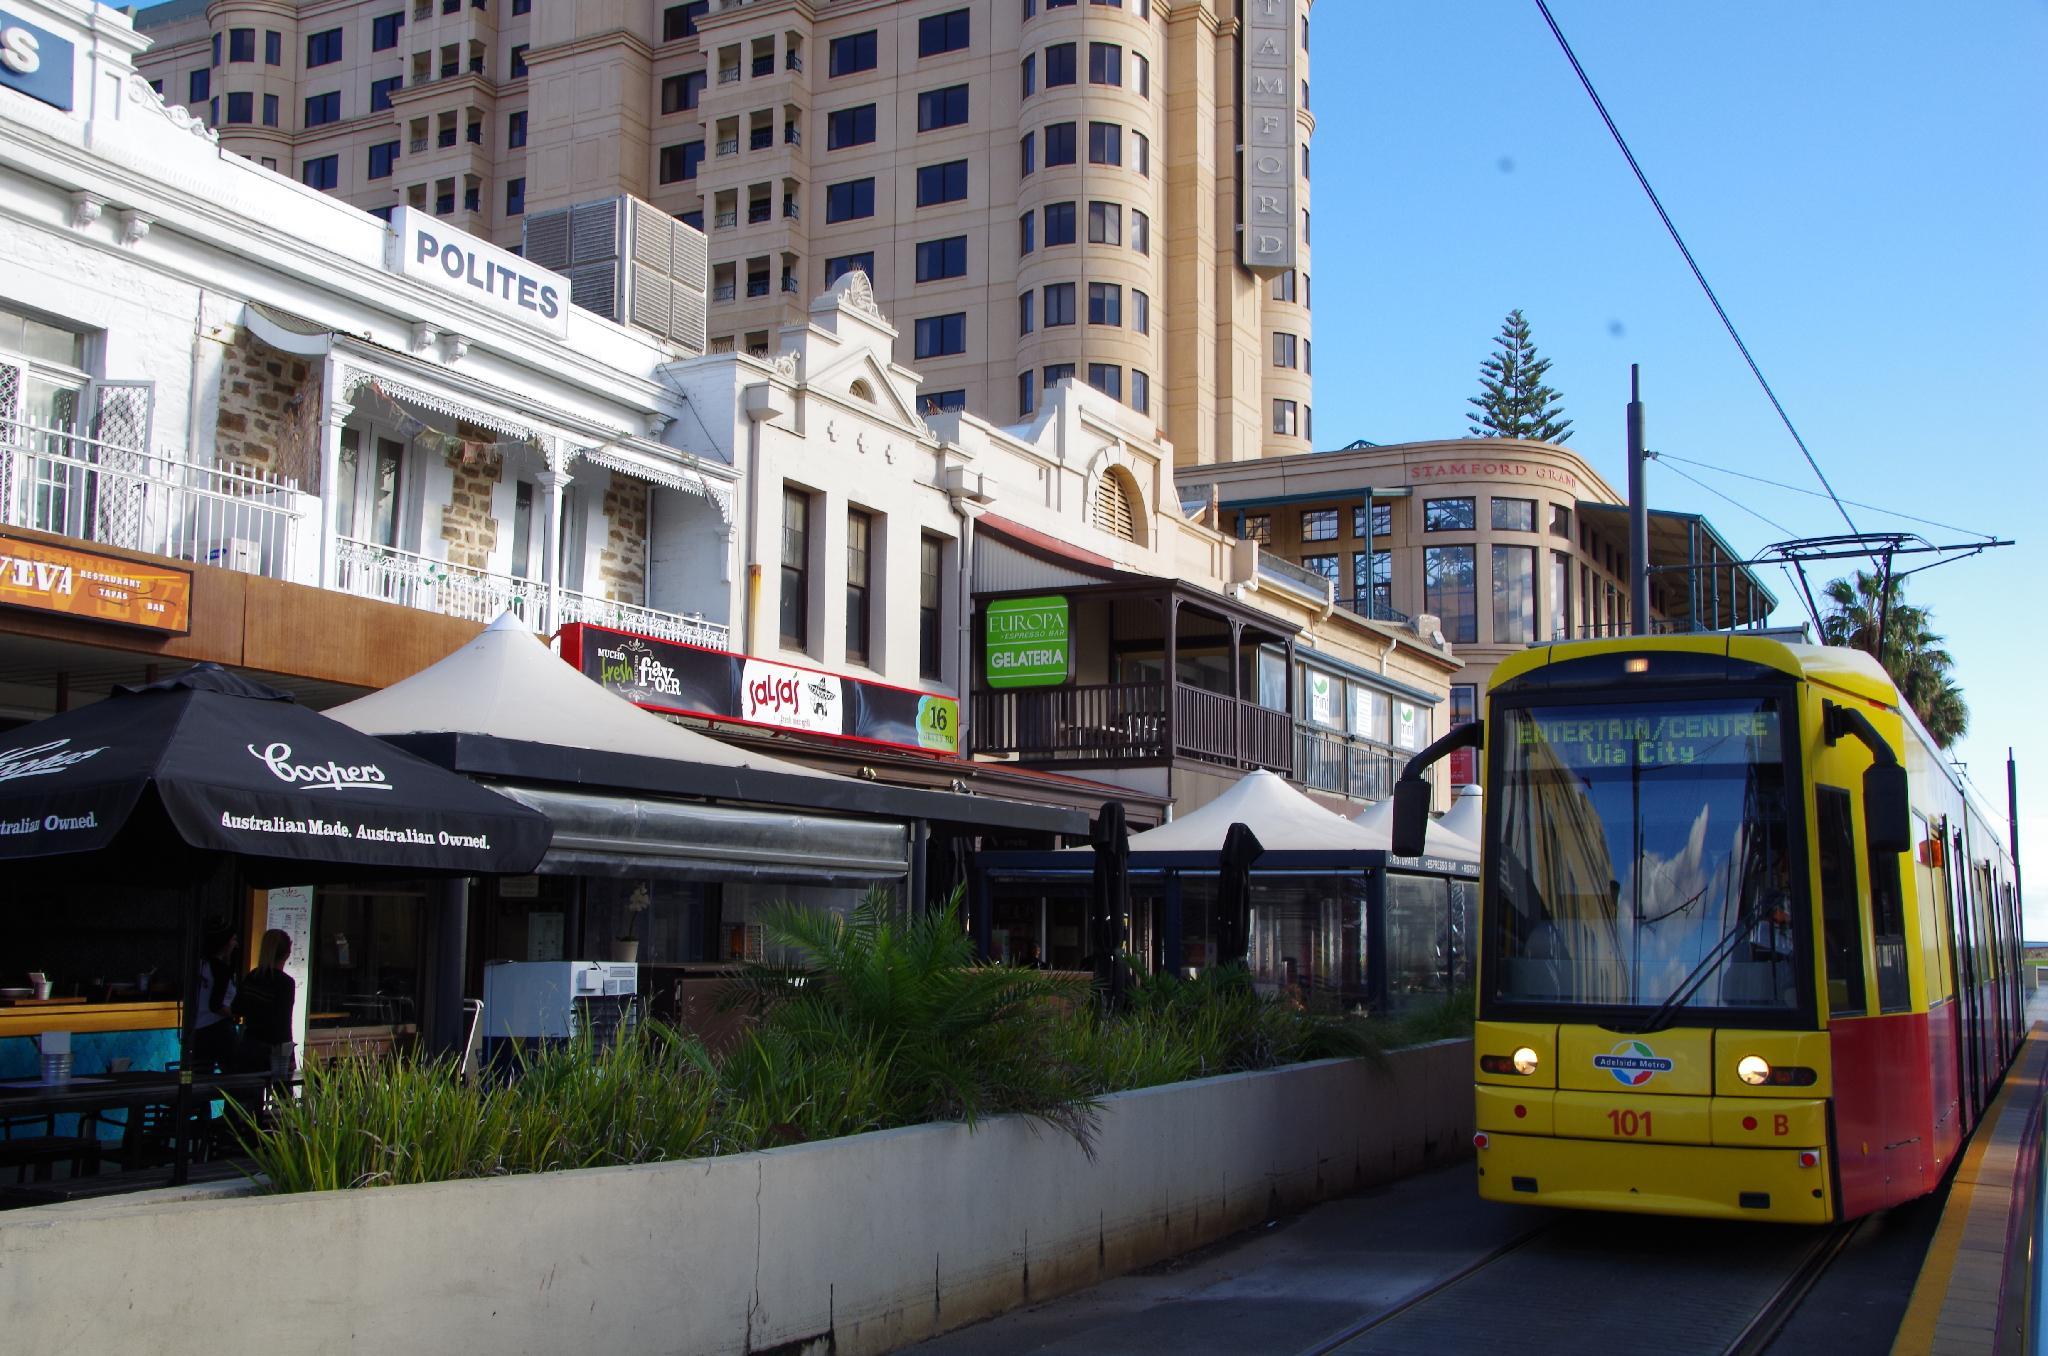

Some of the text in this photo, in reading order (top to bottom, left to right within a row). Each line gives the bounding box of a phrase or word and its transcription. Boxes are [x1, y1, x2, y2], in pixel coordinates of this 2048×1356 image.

[417, 229, 559, 319] POLITES
[1411, 463, 1576, 488] STAMFORD GRAND
[80, 569, 141, 588] RESTAURANT
[99, 588, 128, 600] TAPAS
[147, 602, 165, 613] BAR
[989, 613, 1064, 632] EUROPA
[1048, 629, 1065, 637] BAR
[598, 648, 625, 661] MUCHO
[991, 649, 1064, 668] GELATERIA
[601, 656, 634, 688] fresh
[930, 706, 947, 730] 16
[1586, 742, 1695, 765] Via City
[247, 742, 386, 791] Coopers
[0, 811, 98, 835] tralian Owned.
[221, 811, 490, 850] Australian Made. Australian Owned.
[1600, 1058, 1665, 1069] Adelaide Metro
[1607, 1109, 1652, 1137] 101
[1774, 1114, 1789, 1136] B
